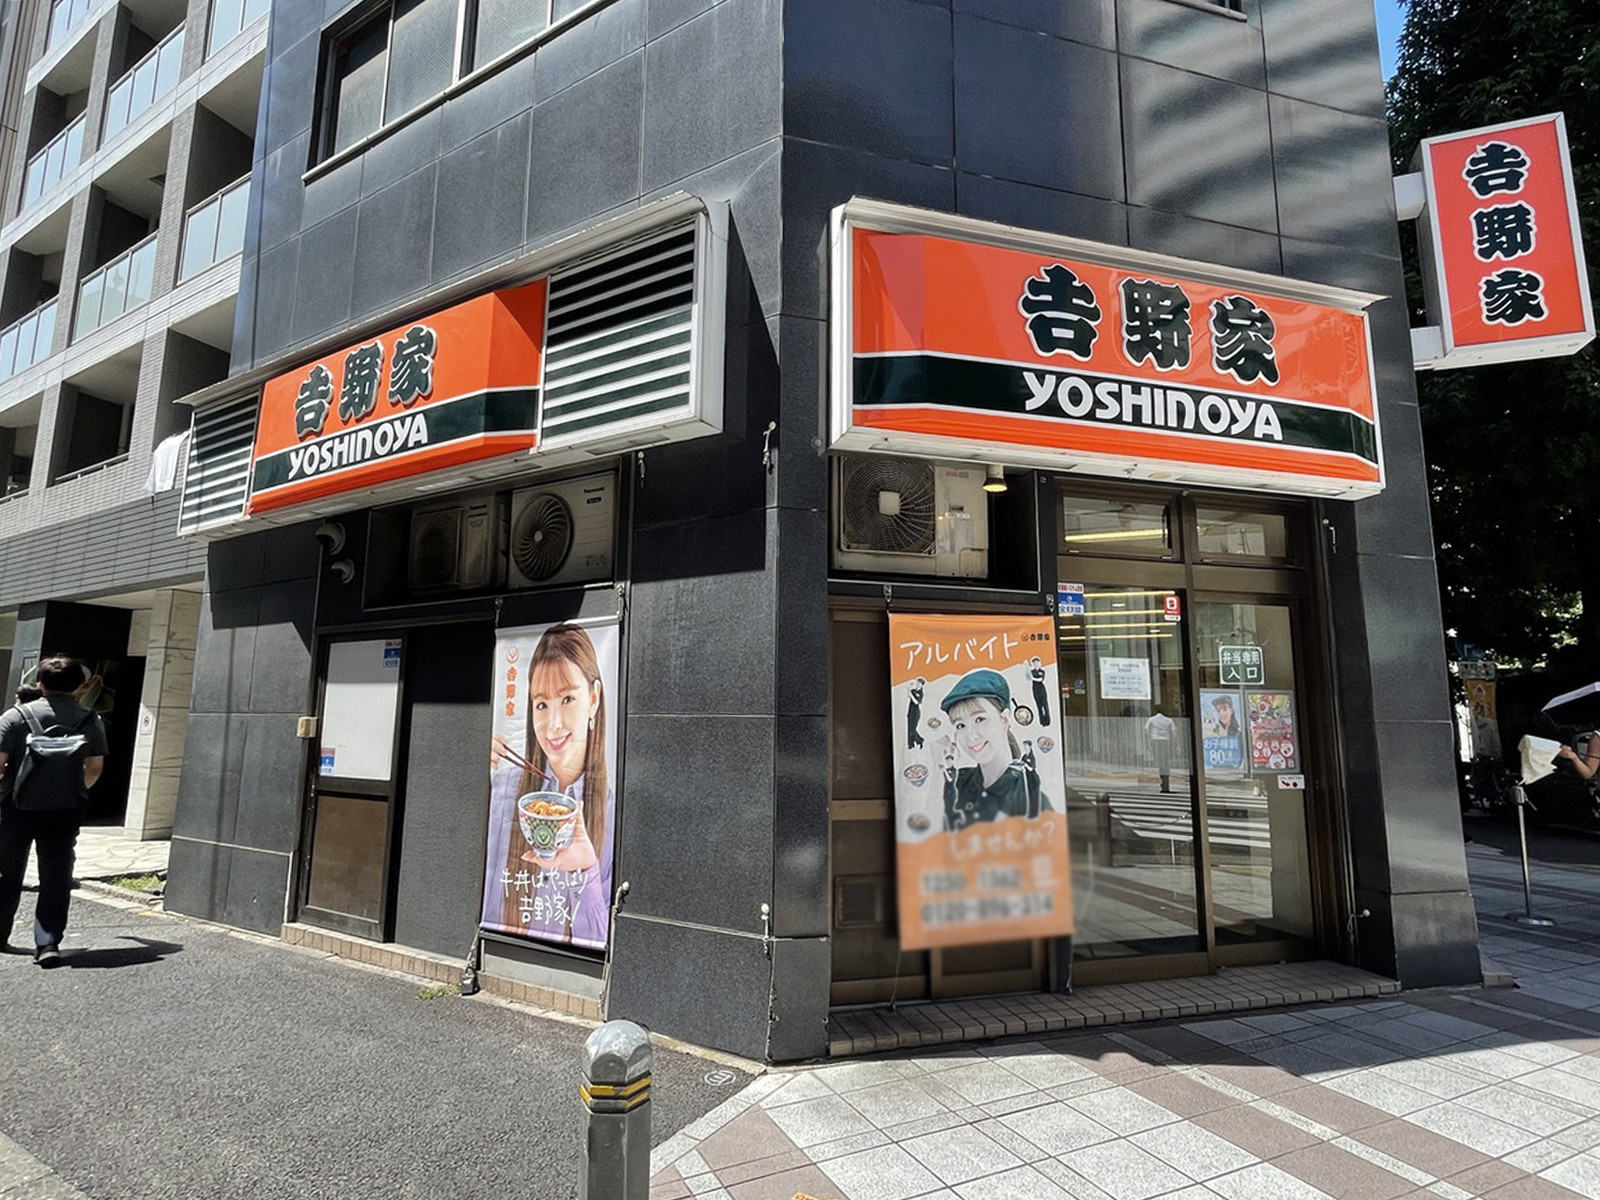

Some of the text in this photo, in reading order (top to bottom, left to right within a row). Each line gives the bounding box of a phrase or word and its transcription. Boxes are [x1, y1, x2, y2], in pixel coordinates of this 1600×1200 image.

[1462, 140, 1548, 327] 吉野家
[1018, 262, 1281, 387] 吉野家
[294, 323, 438, 438] 吉野家
[1022, 371, 1283, 441] YOSHINOYA
[288, 413, 428, 480] YOSHINOYA
[900, 633, 1019, 670] アルバイト
[1227, 667, 1257, 679] 入口
